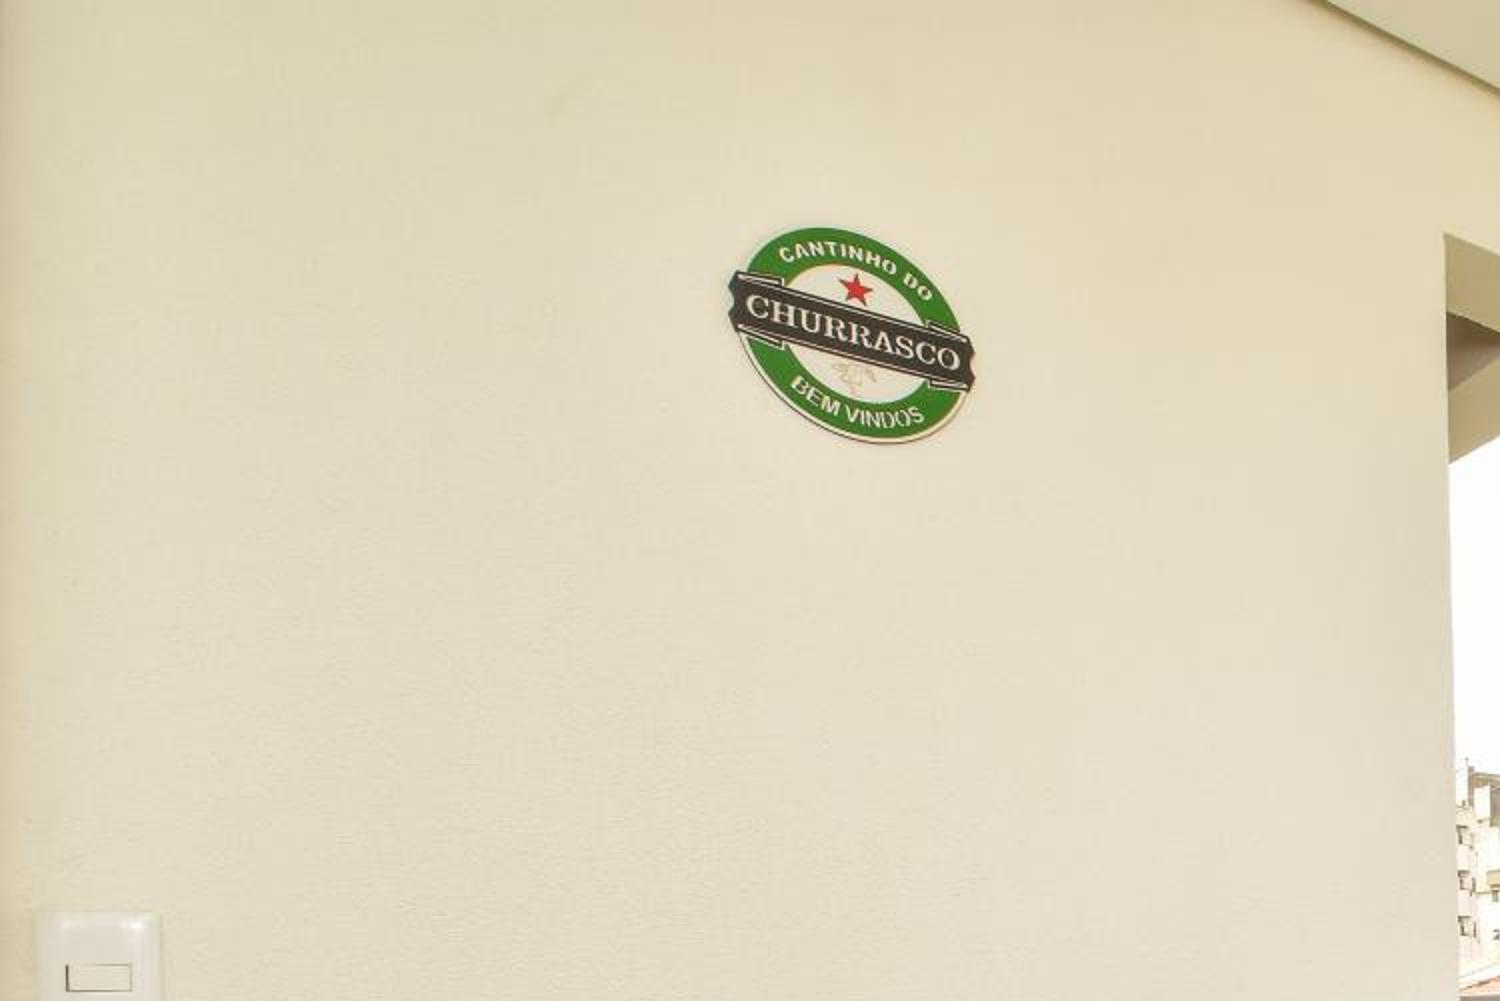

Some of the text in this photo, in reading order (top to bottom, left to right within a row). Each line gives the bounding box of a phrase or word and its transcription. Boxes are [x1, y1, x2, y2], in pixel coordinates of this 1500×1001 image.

[779, 241, 933, 300] CANTINHO DO
[746, 294, 961, 371] CHURRASCO
[792, 375, 925, 429] BEM VINDOS
